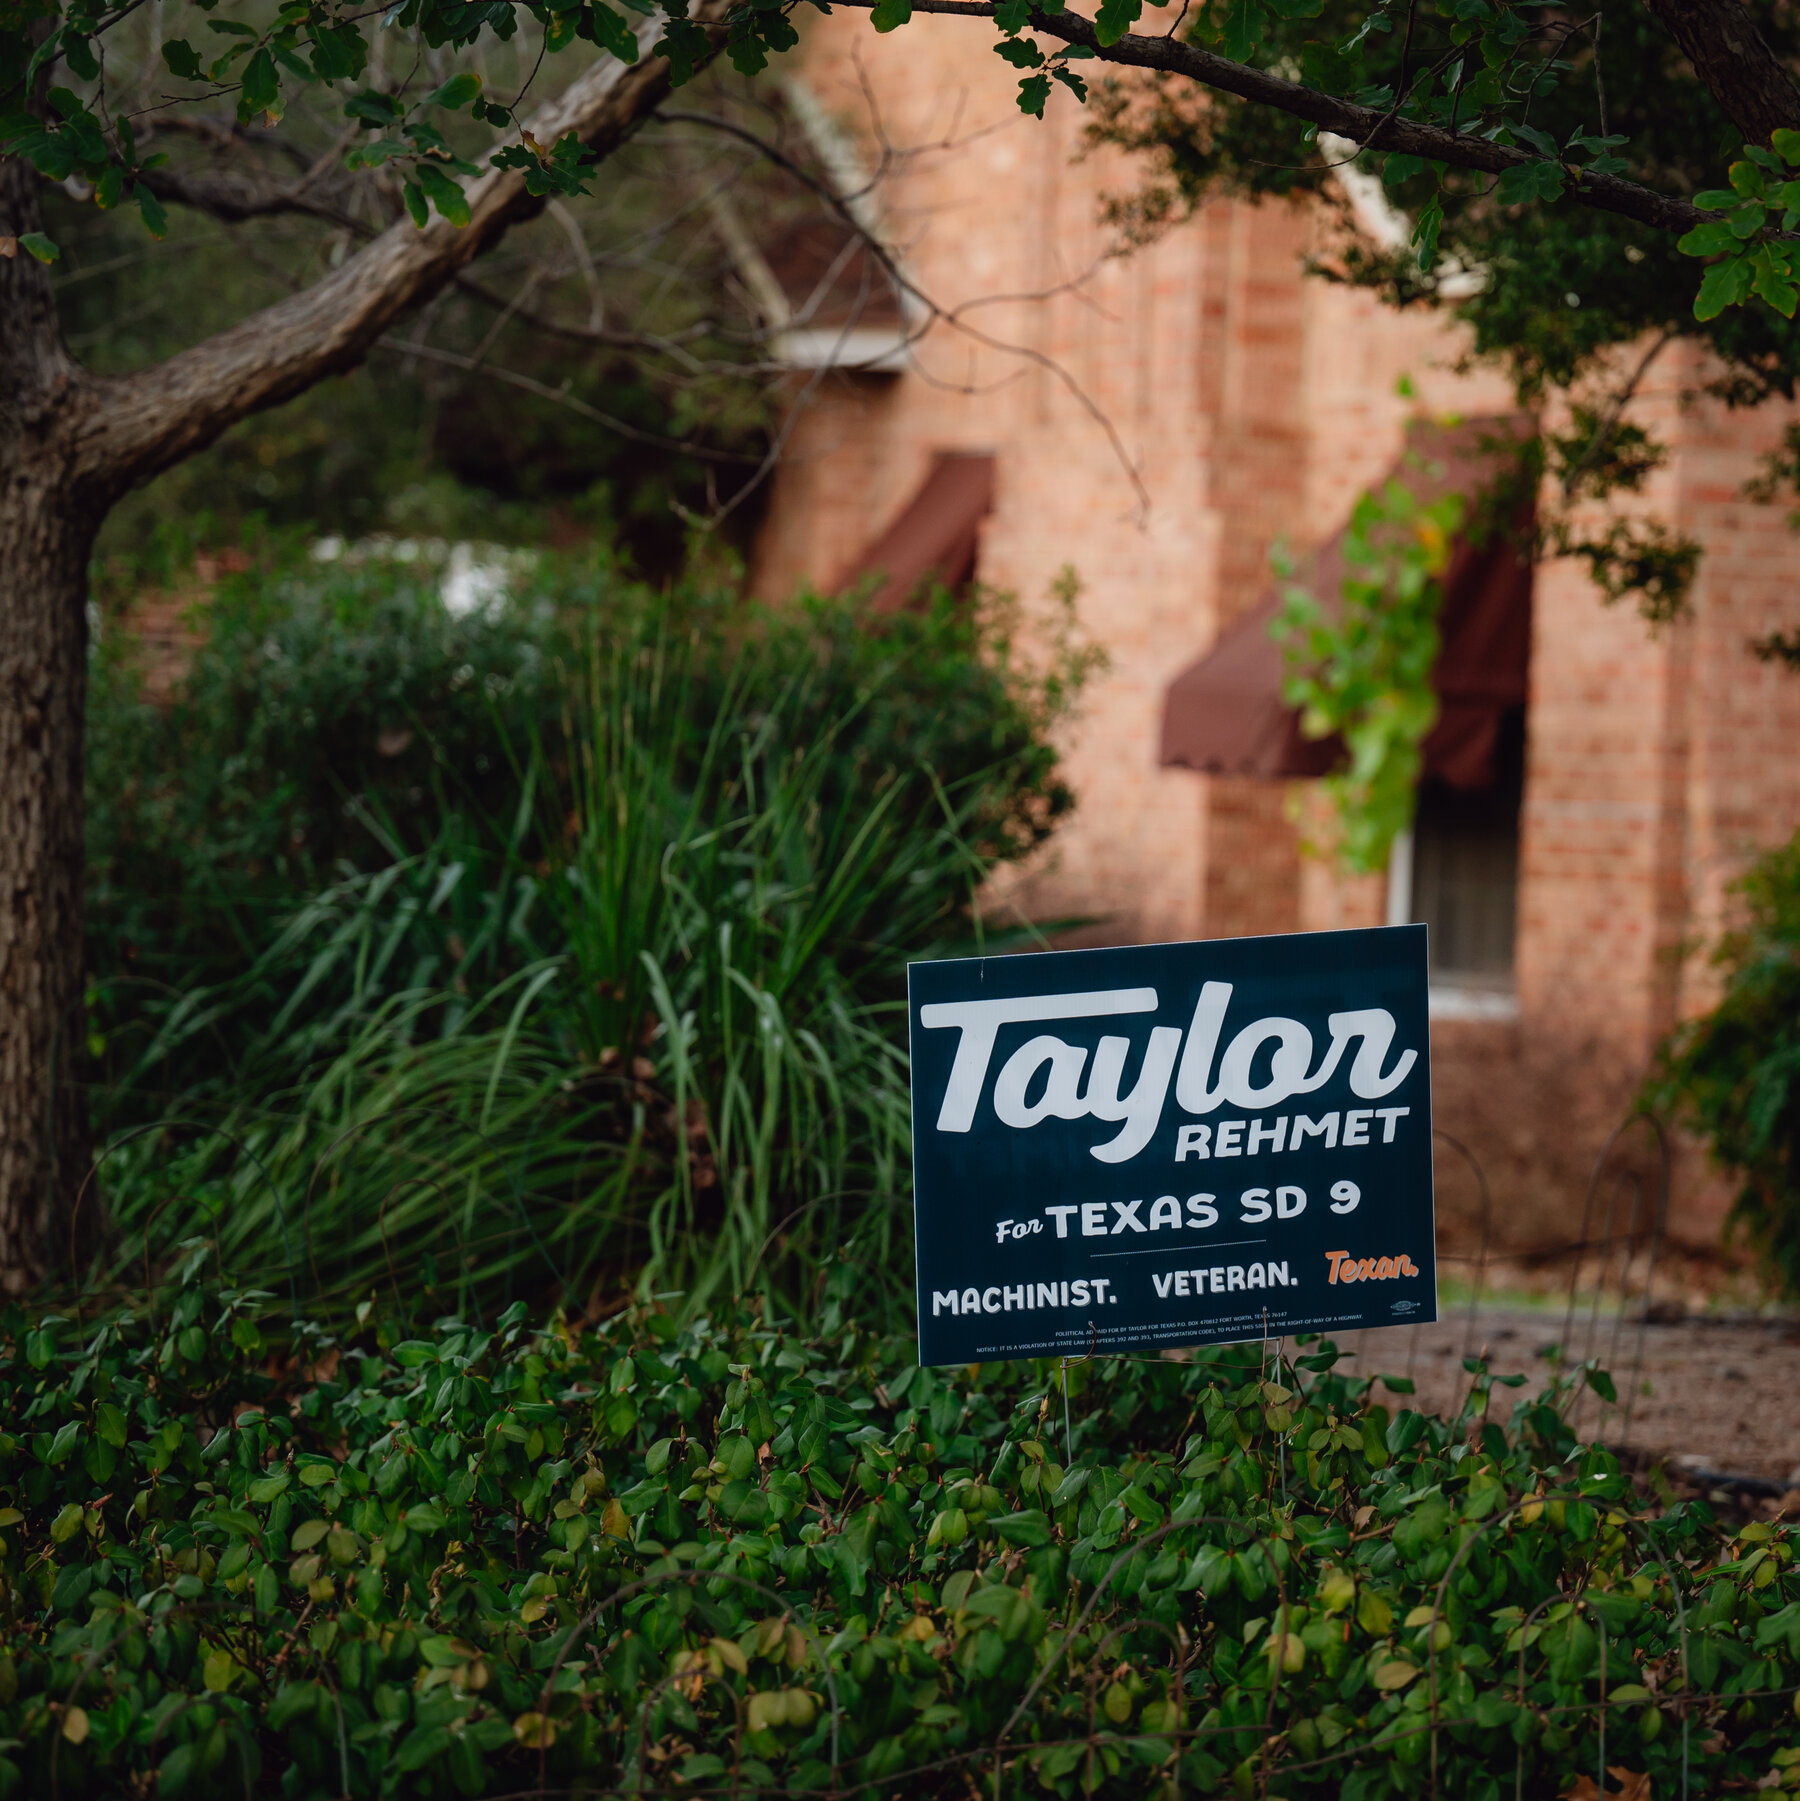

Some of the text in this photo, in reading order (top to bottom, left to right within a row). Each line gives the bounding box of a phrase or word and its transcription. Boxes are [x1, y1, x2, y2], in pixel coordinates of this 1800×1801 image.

[920, 980, 1418, 1163] Taylor
[1175, 1107, 1410, 1162] REHMET
[996, 1180, 1361, 1244] For TEXAS SD 9
[932, 1250, 1420, 1316] MACHINIST. VETERAN. Texan.
[1153, 1331, 1197, 1339] TRANSPORTATION
